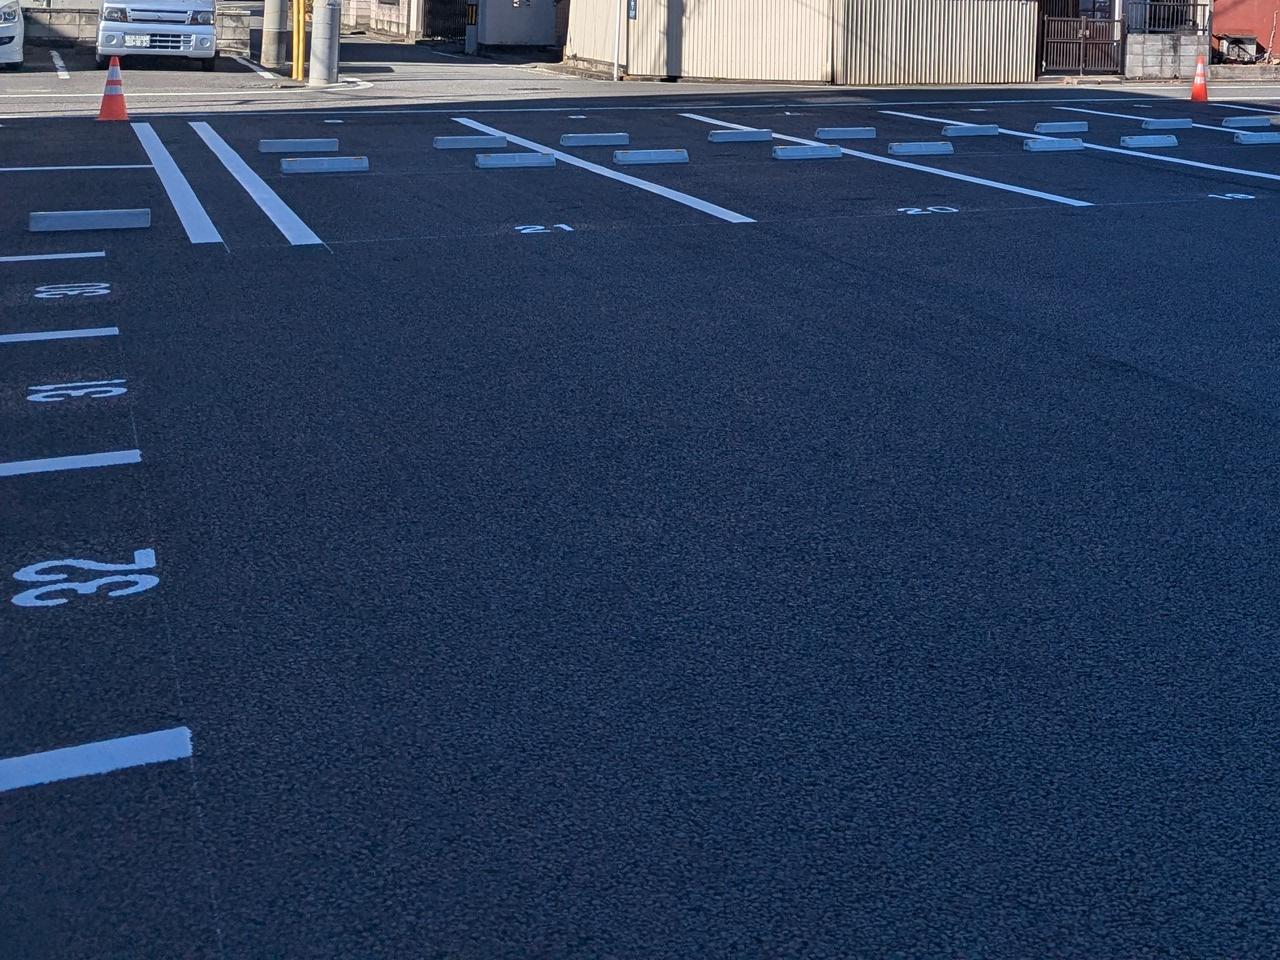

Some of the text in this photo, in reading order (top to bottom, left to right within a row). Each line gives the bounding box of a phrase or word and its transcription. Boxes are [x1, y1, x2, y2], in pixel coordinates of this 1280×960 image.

[896, 206, 960, 215] 20
[514, 223, 575, 234] 21
[33, 282, 112, 298] 30
[26, 379, 128, 402] 31
[10, 548, 160, 607] 32
